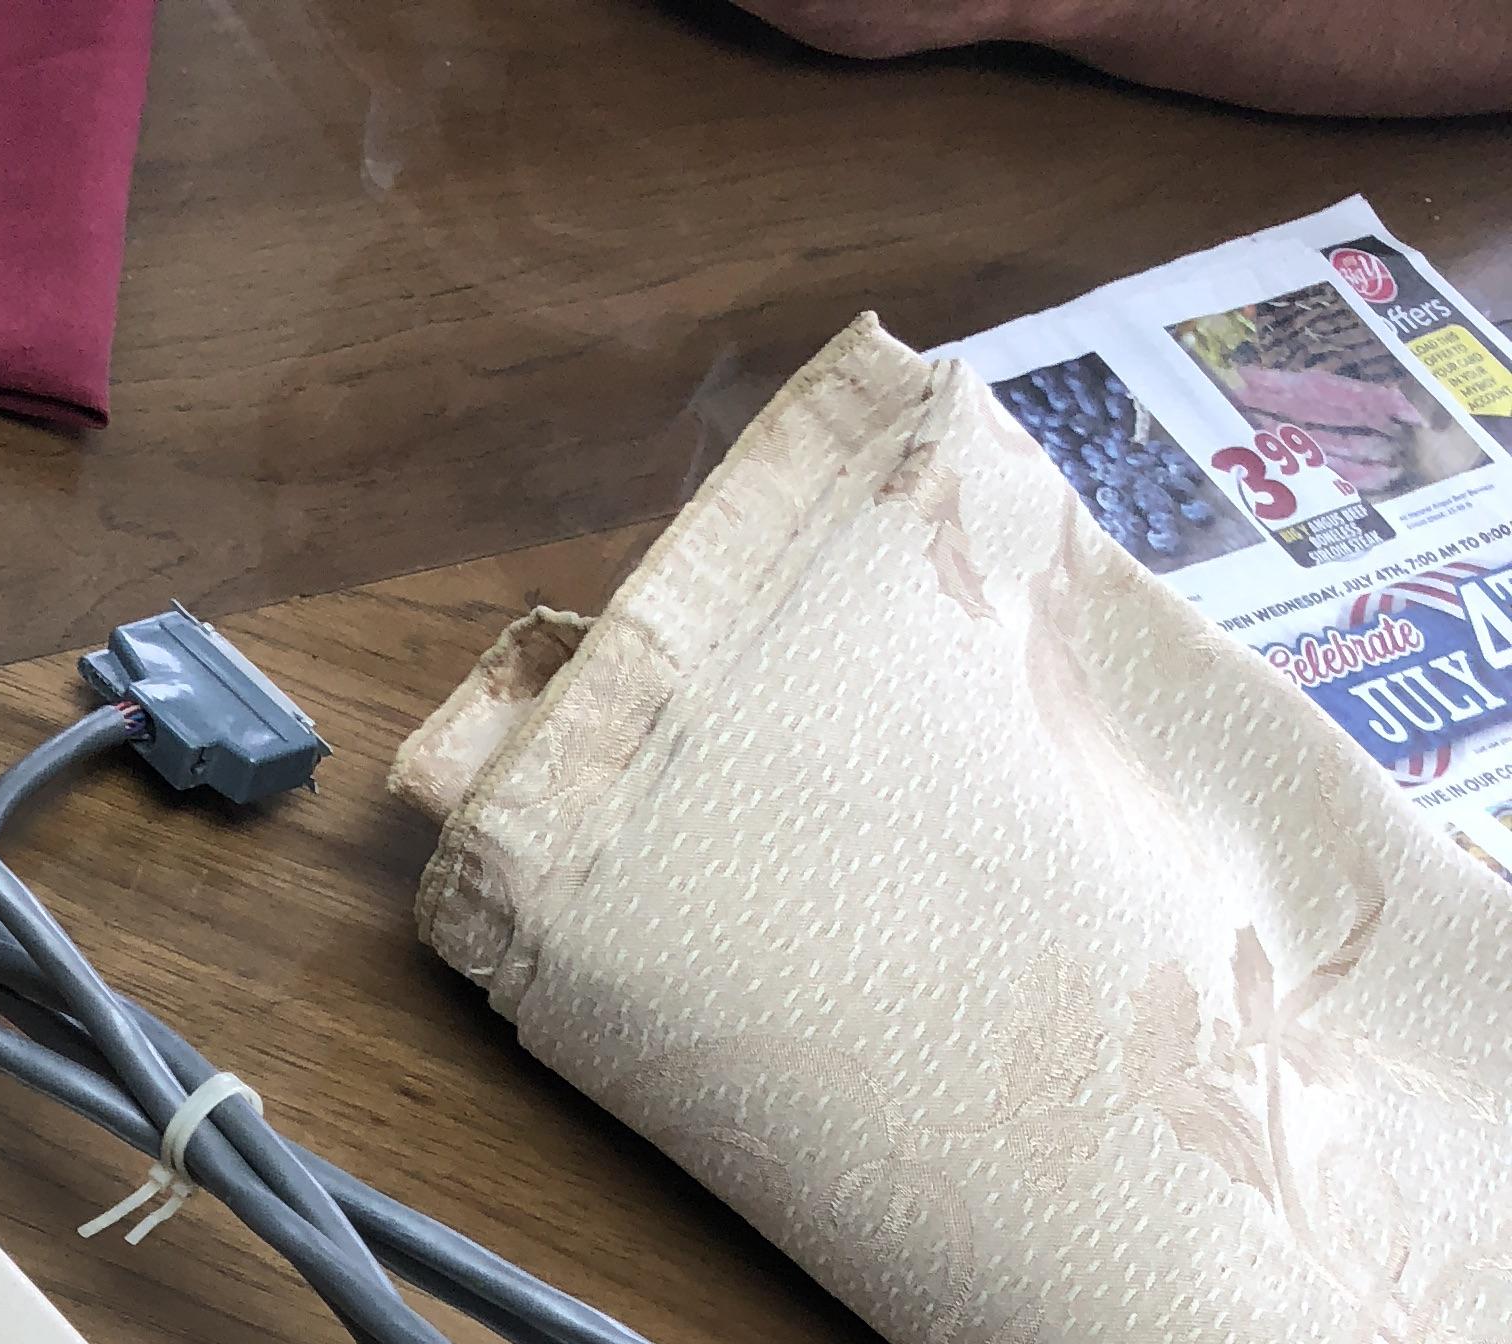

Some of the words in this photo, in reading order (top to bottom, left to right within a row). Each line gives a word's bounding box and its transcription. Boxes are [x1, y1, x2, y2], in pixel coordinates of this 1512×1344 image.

[1251, 585, 1345, 623] WEDNESDAY,
[1342, 574, 1374, 593] JULY
[1404, 552, 1438, 570] 7:00
[1438, 543, 1462, 559] AM
[1458, 536, 1480, 551] TO
[1348, 650, 1506, 743] JULY
[1446, 784, 1468, 797] IN
[1464, 772, 1499, 791] OUR
